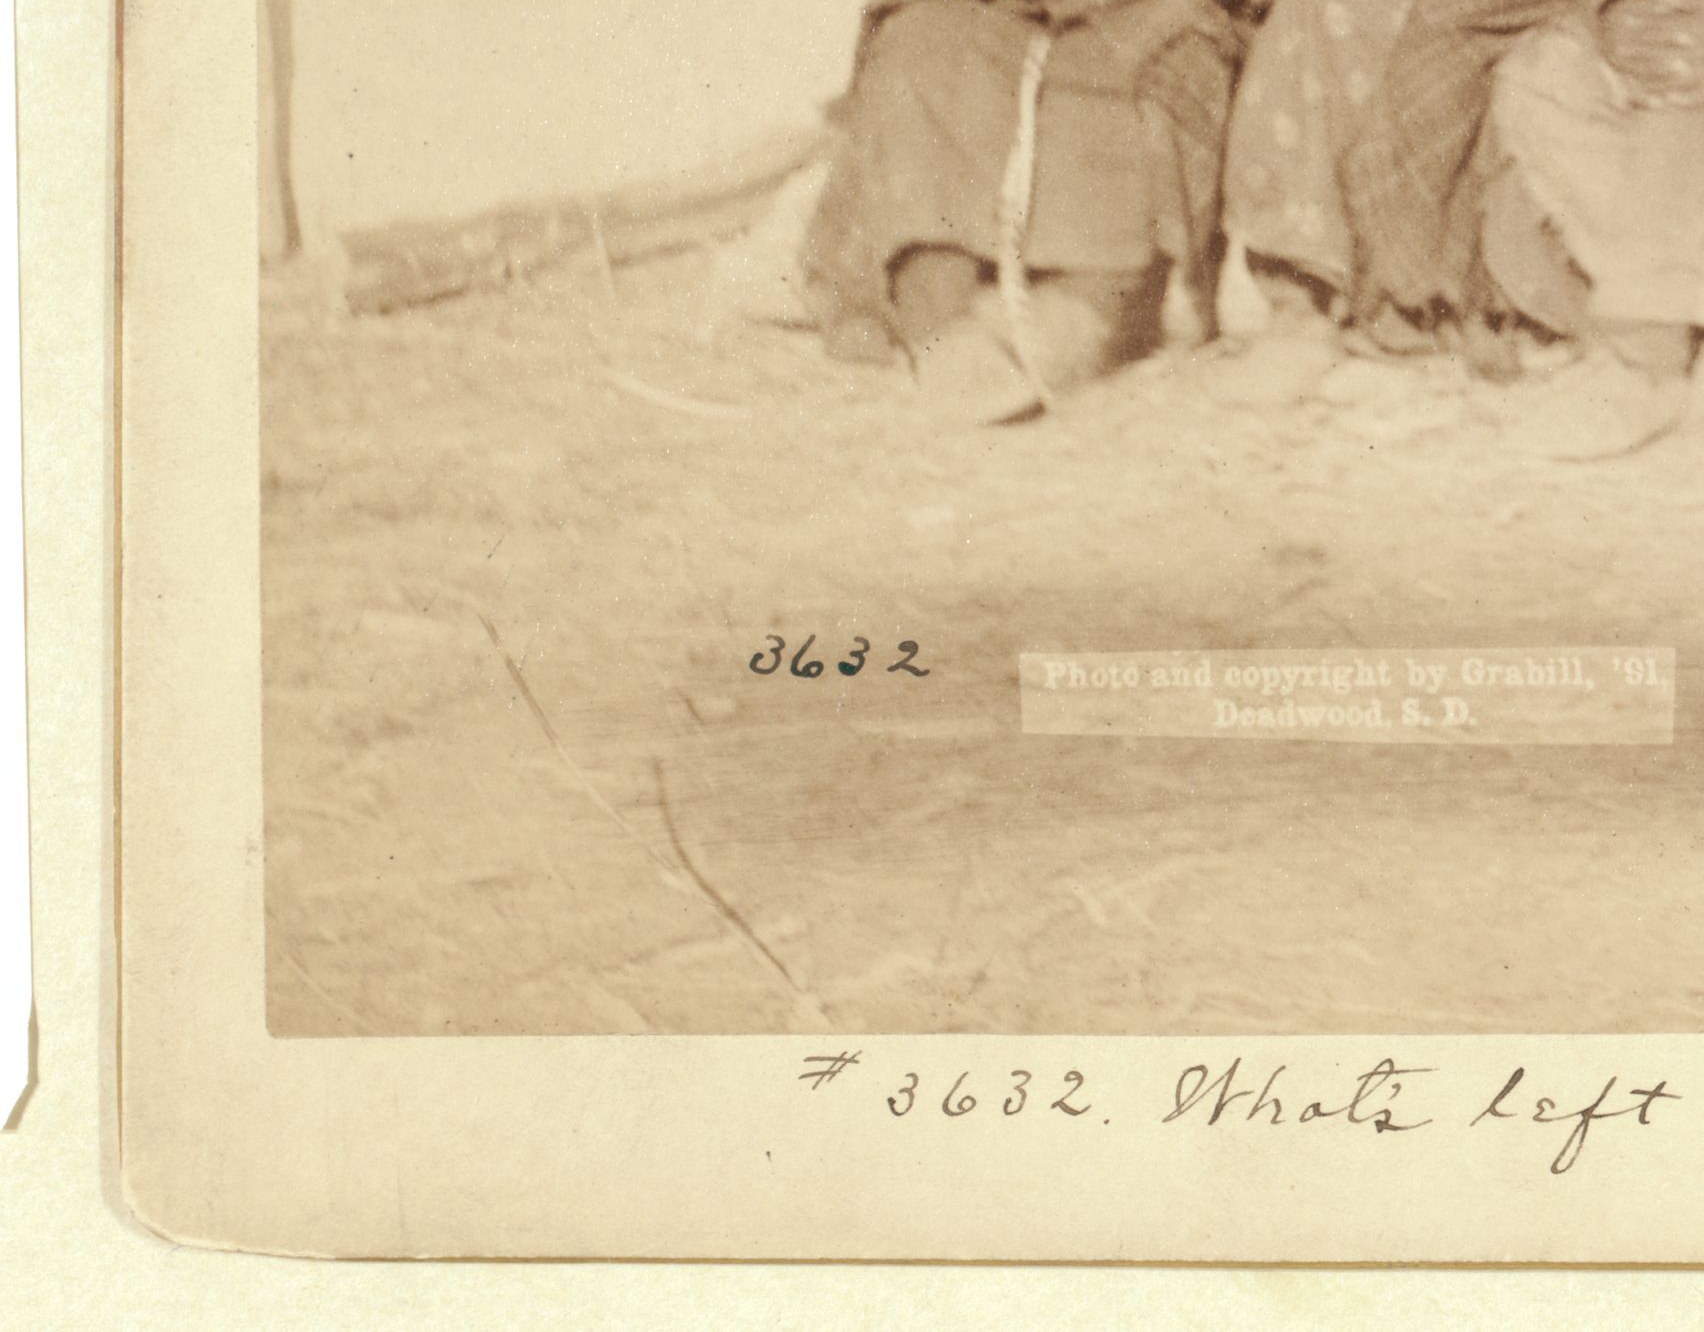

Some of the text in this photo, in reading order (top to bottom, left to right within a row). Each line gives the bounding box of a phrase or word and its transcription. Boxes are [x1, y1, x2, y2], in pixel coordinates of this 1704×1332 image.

[749, 634, 930, 679] 3632
[886, 1070, 1110, 1125] 3632.
[1470, 1067, 1682, 1175] left
